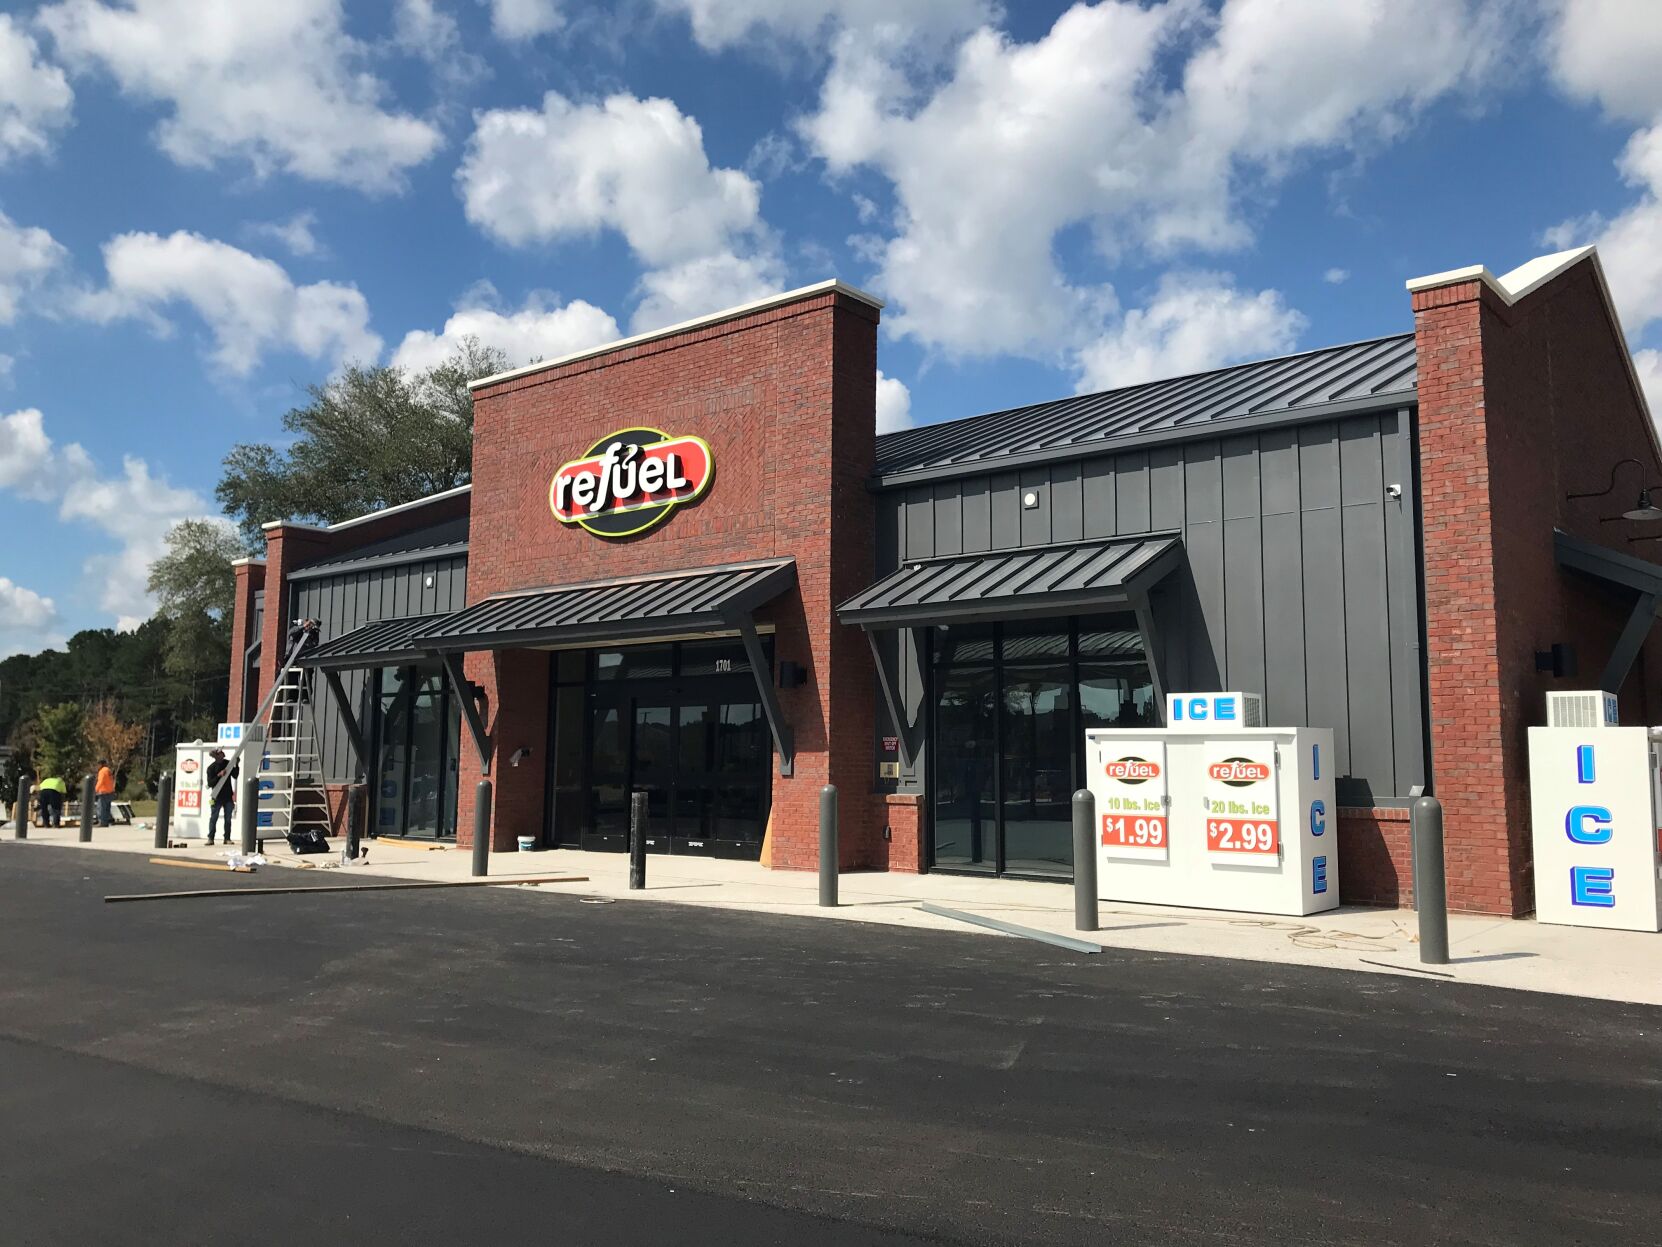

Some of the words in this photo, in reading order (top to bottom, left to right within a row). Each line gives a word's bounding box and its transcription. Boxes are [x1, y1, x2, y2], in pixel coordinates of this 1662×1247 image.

[715, 659, 732, 672] 1701
[1173, 697, 1236, 720] ICE
[220, 726, 241, 739] ICE
[1108, 797, 1121, 810] 10
[1123, 798, 1142, 811] lbs.
[1144, 798, 1161, 812] Ice
[1211, 800, 1225, 814] 20
[1228, 801, 1249, 815] lbs.
[1251, 801, 1270, 815] Ice
[1310, 744, 1328, 894] ICE
[1565, 745, 1615, 907] ICE
[1106, 817, 1163, 845] $1.99
[1209, 822, 1273, 851] $2.99
